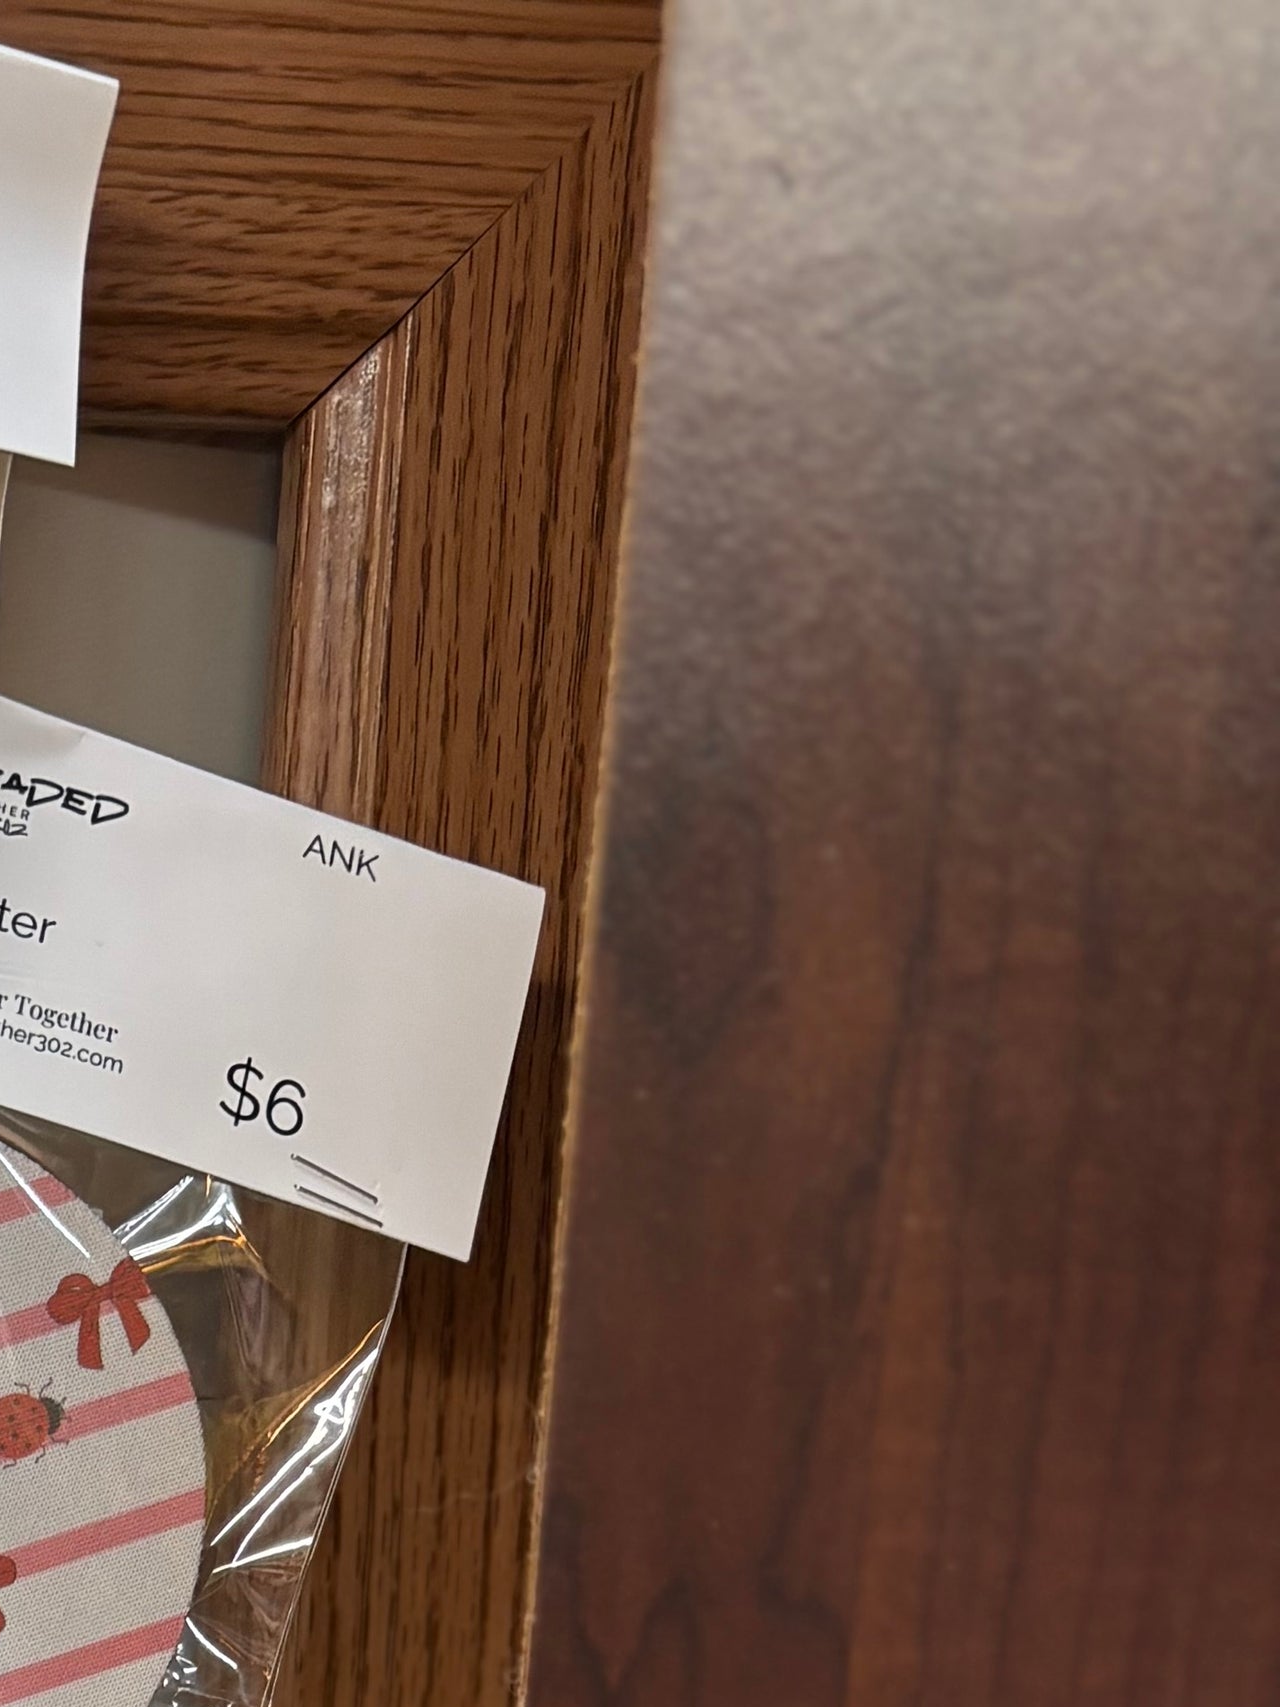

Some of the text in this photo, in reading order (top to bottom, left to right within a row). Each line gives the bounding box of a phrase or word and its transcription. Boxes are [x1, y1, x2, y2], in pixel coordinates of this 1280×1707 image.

[302, 834, 382, 884] ANK
[14, 993, 120, 1044] Together
[218, 1057, 307, 1138] $6
